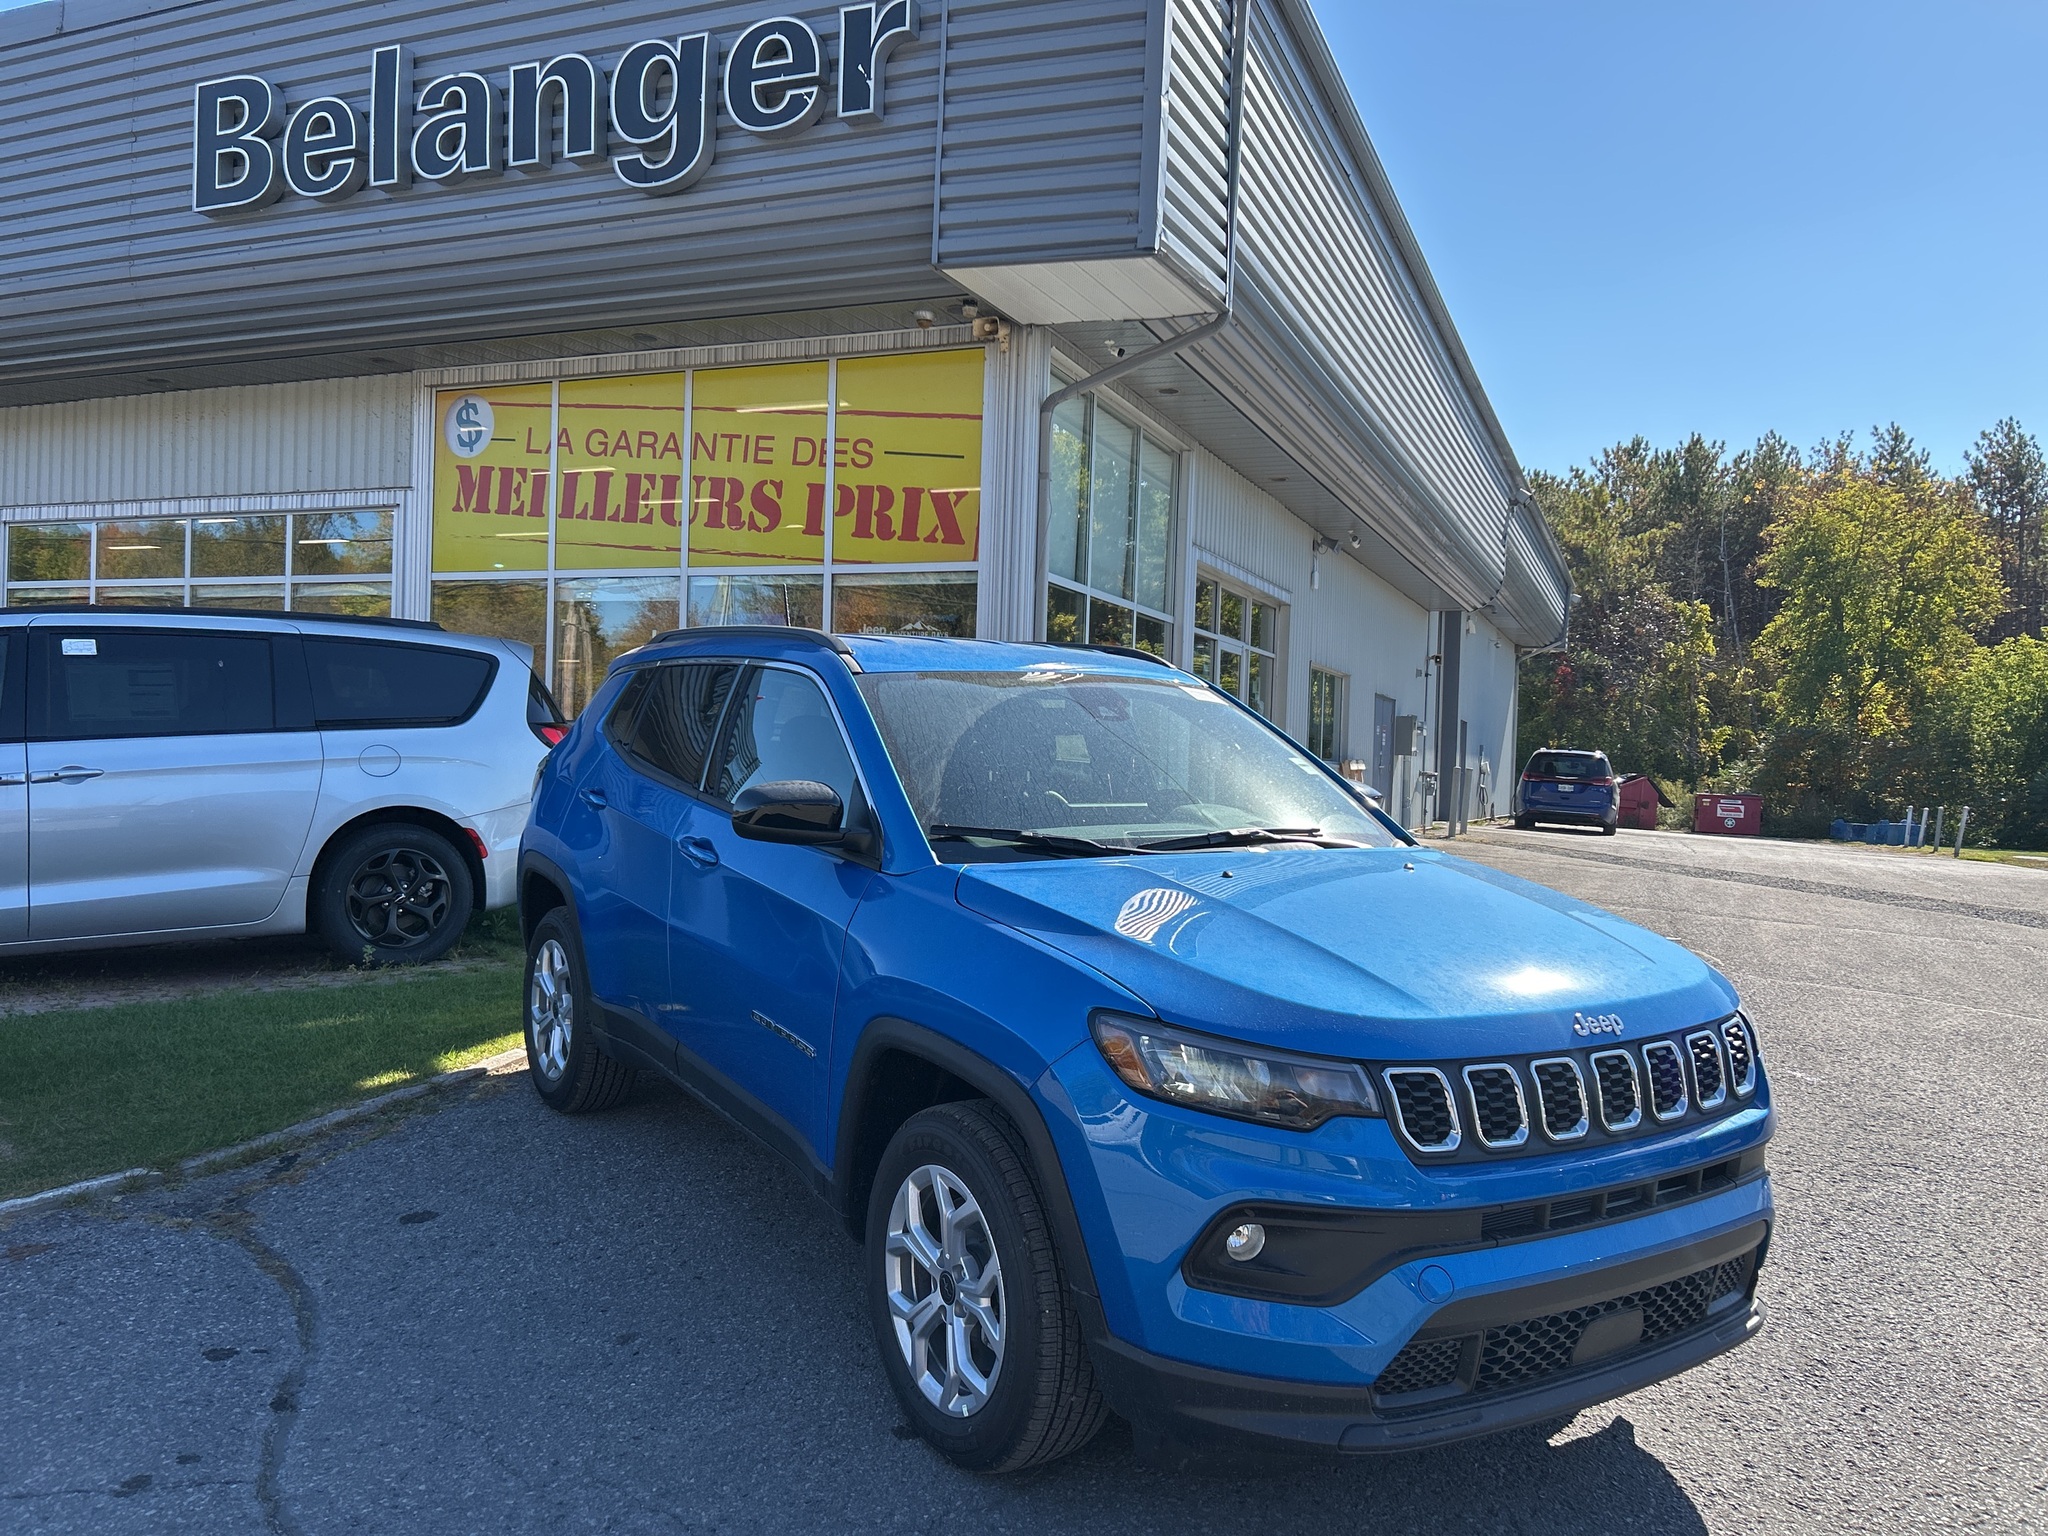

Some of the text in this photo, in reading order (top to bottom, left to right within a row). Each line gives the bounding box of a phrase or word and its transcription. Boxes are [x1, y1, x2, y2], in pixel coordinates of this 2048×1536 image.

[193, 0, 916, 214] Belanger
[525, 426, 874, 469] LA GARANTIE DES
[452, 464, 969, 545] MEILLEURS PRIX
[1574, 1012, 1624, 1037] Jeep
